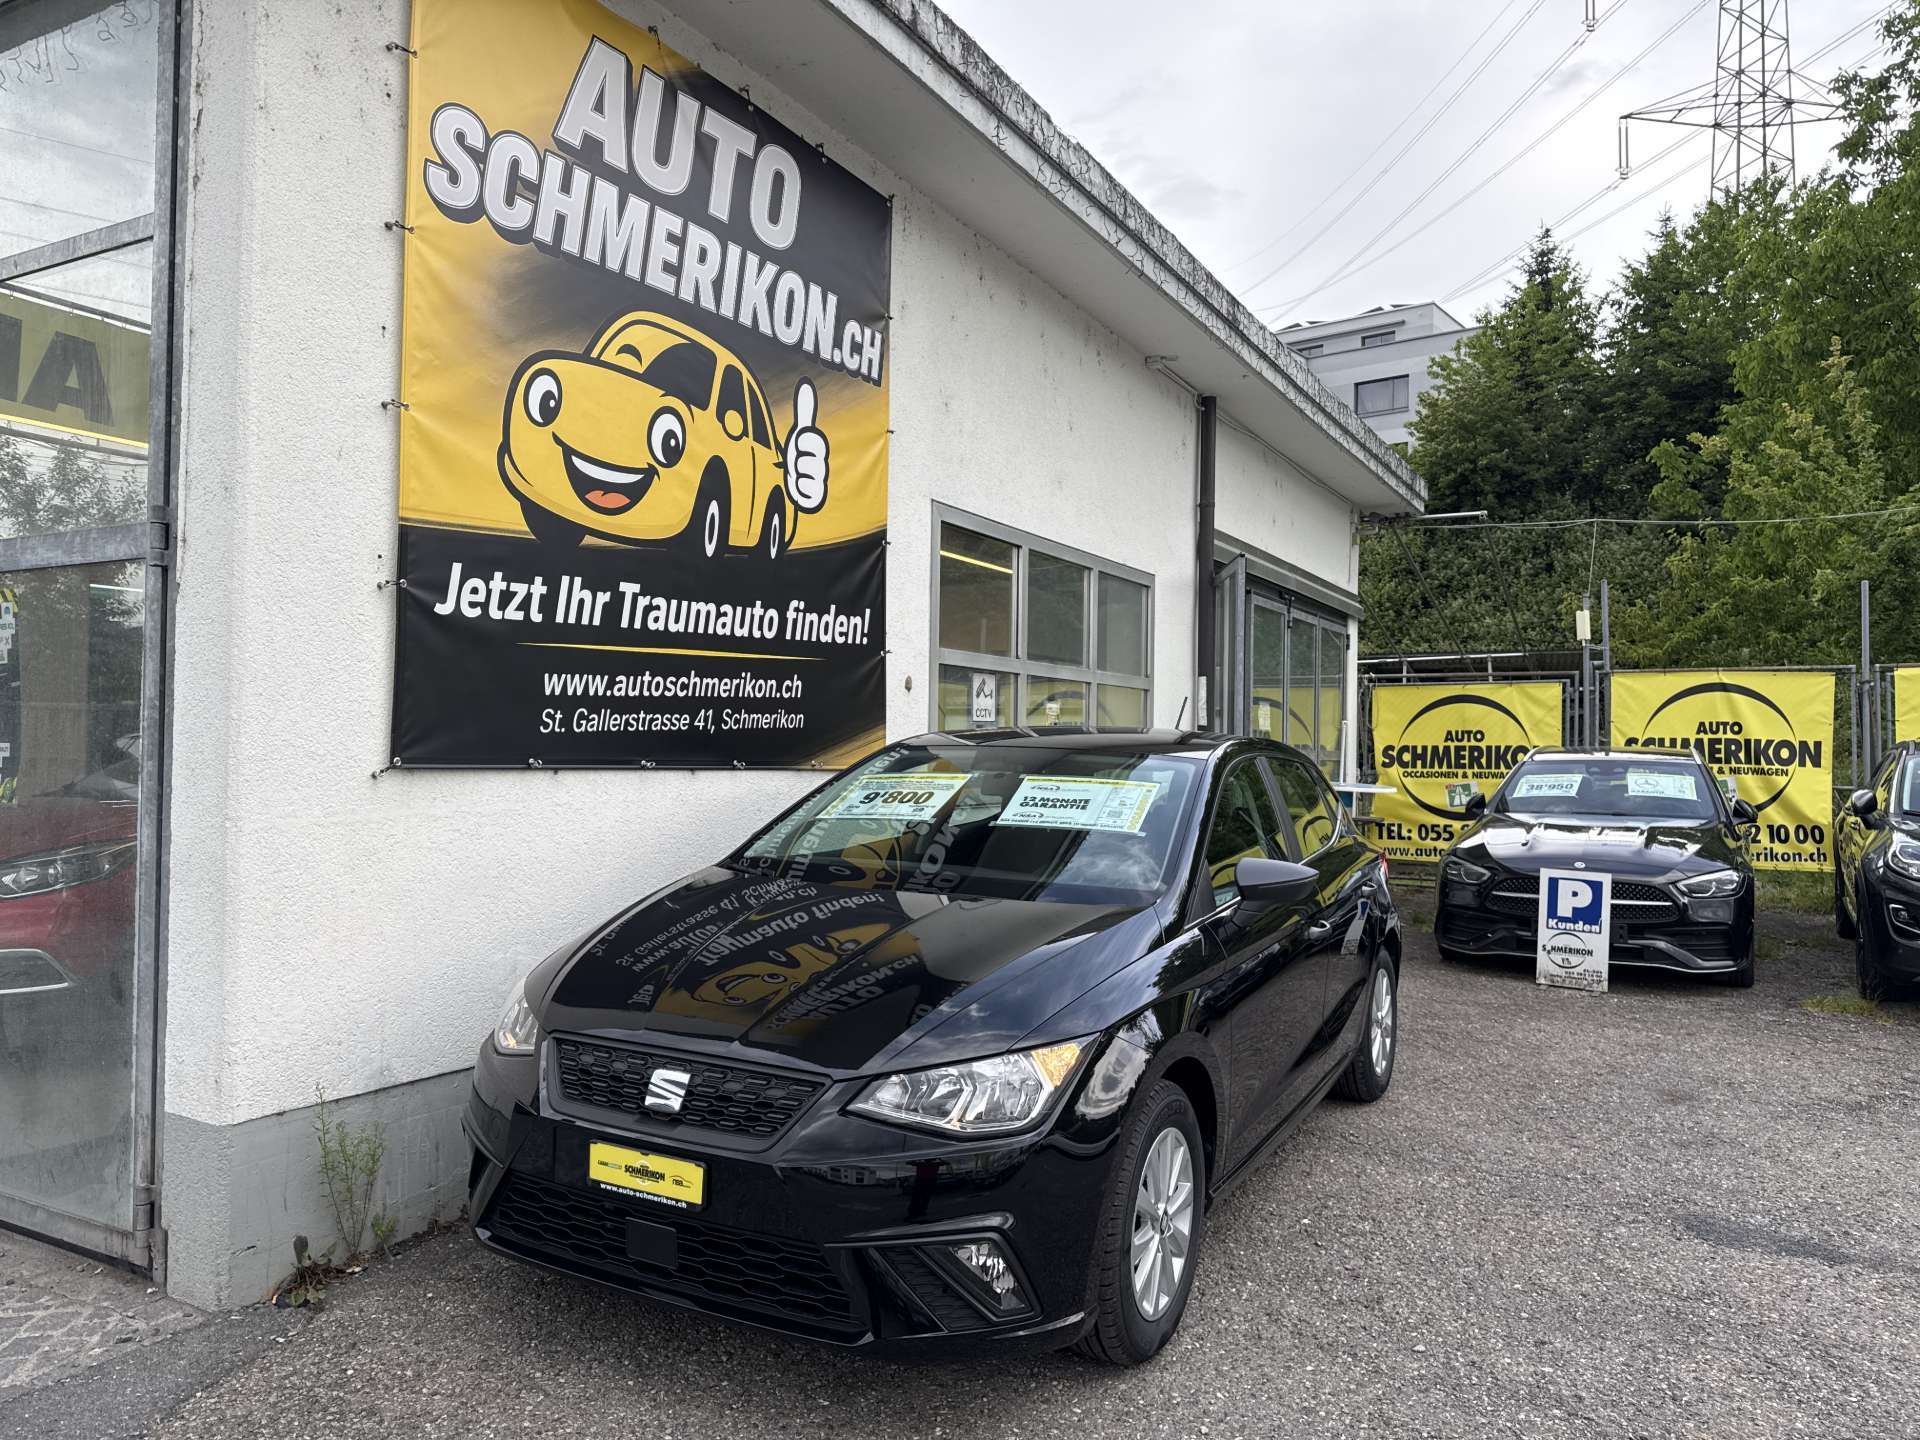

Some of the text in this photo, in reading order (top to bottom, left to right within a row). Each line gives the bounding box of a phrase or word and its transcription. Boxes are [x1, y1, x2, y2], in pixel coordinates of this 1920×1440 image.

[553, 37, 802, 250] AUTO
[425, 104, 884, 381] SCHMERIKON.CH
[433, 562, 871, 645] Jetzt Ihr Traumauto finden!
[543, 670, 802, 698] www.autoschmerikon.ch
[539, 707, 805, 734] St. Gallerstrasse 41, Schmerikon
[975, 707, 993, 718] CCTV
[1444, 730, 1485, 743] AUTO
[1695, 721, 1743, 735] AUTO
[1381, 744, 1539, 770] SCHMERIKO
[1402, 770, 1459, 779] OCCASIONEN
[1461, 771, 1469, 779] &
[1717, 766, 1725, 775] &
[1729, 766, 1788, 777] NEUWAGEN
[859, 791, 935, 805] 9'800
[1019, 802, 1089, 811] GARANTIE
[1038, 796, 1092, 805] MONATE
[1375, 822, 1455, 842] TEL: 055
[1766, 823, 1790, 844] 10
[1794, 823, 1825, 845] 00
[1557, 879, 1593, 918] P
[1547, 917, 1602, 934] Kunden
[623, 1164, 666, 1182] SCHMERIKON
[600, 1183, 687, 1209] www.auto-schmerikon.ch
